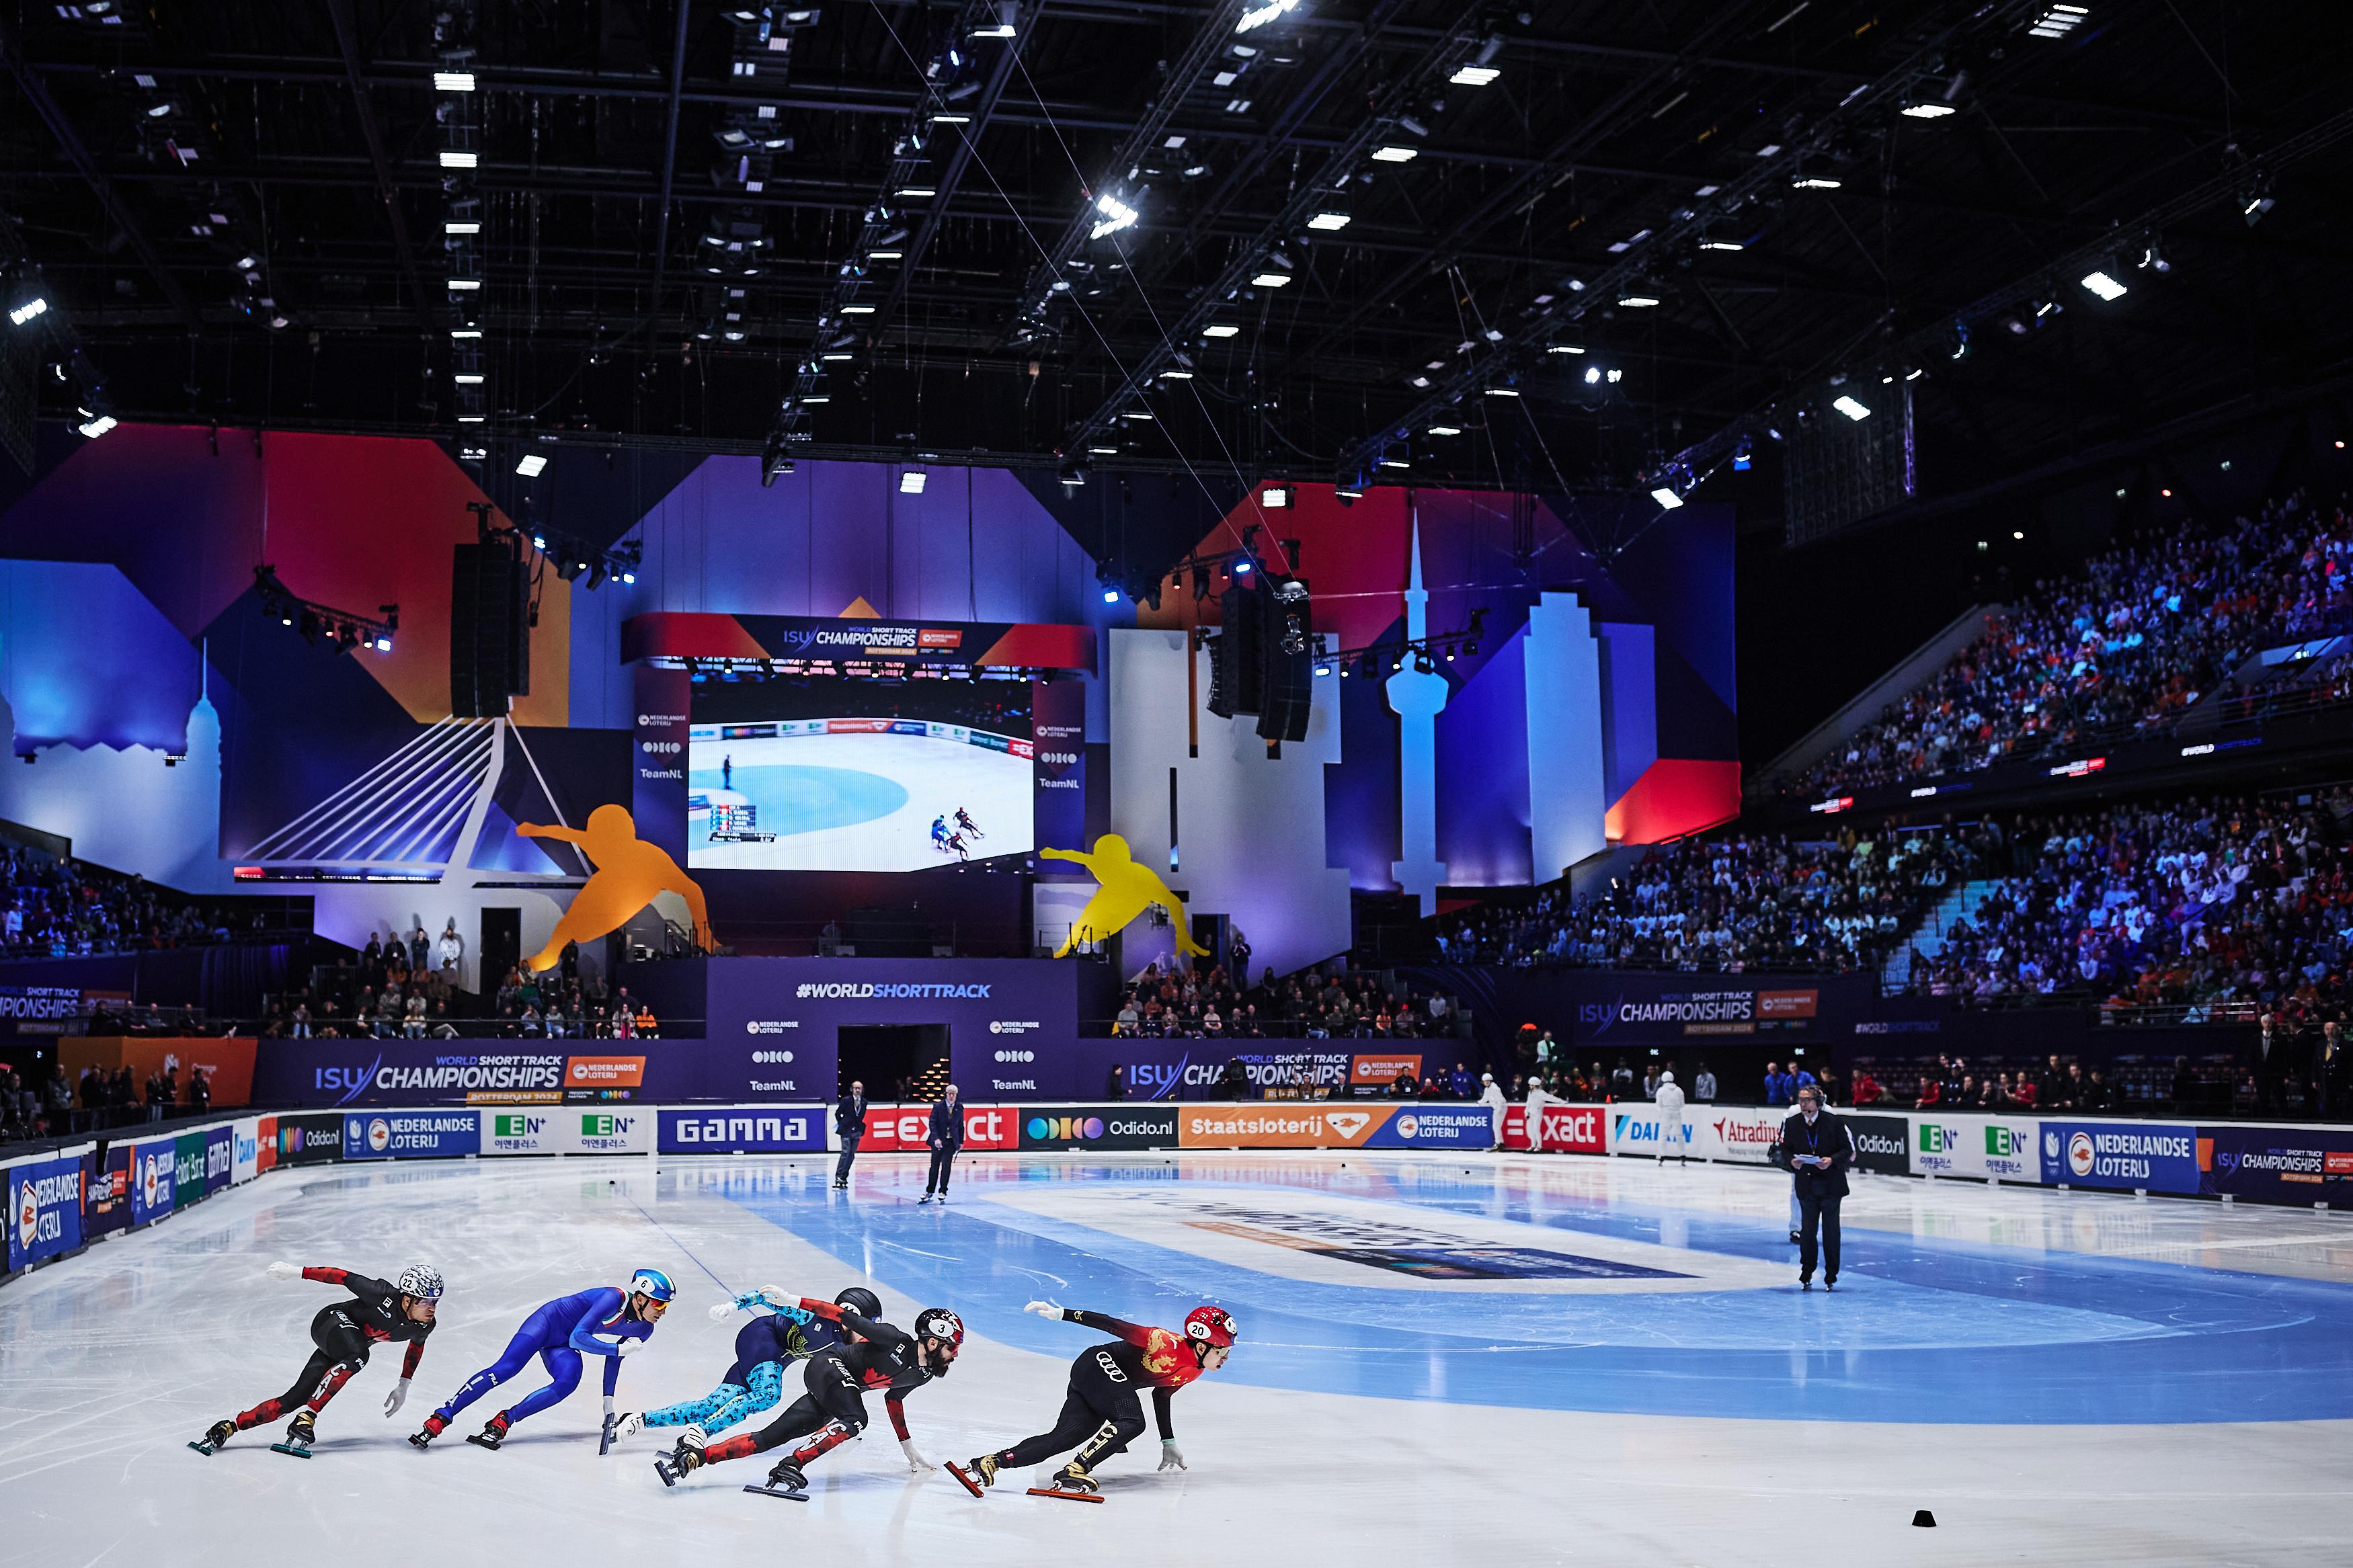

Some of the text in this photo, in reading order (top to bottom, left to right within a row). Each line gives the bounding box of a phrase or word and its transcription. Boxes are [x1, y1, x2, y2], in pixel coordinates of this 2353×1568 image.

[784, 630, 916, 647] ISU CHAMPIONSHIPS
[640, 769, 682, 778] TeamNL
[1039, 778, 1079, 788] TeamNL
[27, 987, 53, 996] SHORT
[54, 989, 80, 997] TRACK
[796, 983, 992, 998] #WORLDSHORTTRACK
[1692, 993, 1721, 1001] SHORT
[1723, 991, 1753, 1000] TRACK
[0, 997, 79, 1018] PIONSHIPS
[1620, 1001, 1751, 1022] CHAMPIONSHIPS
[436, 1056, 562, 1065] WORLD SHORT TRACK
[1314, 1055, 1348, 1063] TRACK
[316, 1067, 559, 1089] ISU CHAMPIONSHIPS
[1131, 1065, 1172, 1085] ISU
[750, 1080, 796, 1090] TeamNL
[992, 1079, 1036, 1089] TeamNL
[390, 1118, 474, 1132] NEDERLANDSE
[1110, 1120, 1172, 1136] Odido.nl
[1191, 1116, 1322, 1137] Staatsloterij
[1419, 1115, 1487, 1127] NEDERLANDSE
[1419, 1128, 1458, 1138] LOTERIJ
[1630, 1122, 1693, 1143] DAIN
[390, 1134, 438, 1148] LOTERIJ
[495, 1140, 539, 1149] 이엔플러스
[582, 1139, 627, 1148] 이엔플러스
[1858, 1134, 1904, 1155] Odido.nl
[2096, 1134, 2190, 1158] NEDERLANDSE
[1986, 1159, 2022, 1173] 이엔플러스
[2096, 1157, 2150, 1179] LOTERIJ
[2243, 1154, 2321, 1172] CHAMPIONSHIPS
[403, 1278, 412, 1288] 22
[641, 1280, 648, 1288] 6
[938, 1324, 945, 1333] 3
[1191, 1324, 1205, 1336] 20
[312, 1362, 348, 1401] CAN
[488, 1372, 498, 1386] FILA
[853, 1420, 864, 1432] FIL
[1082, 1423, 1119, 1459] CHN
